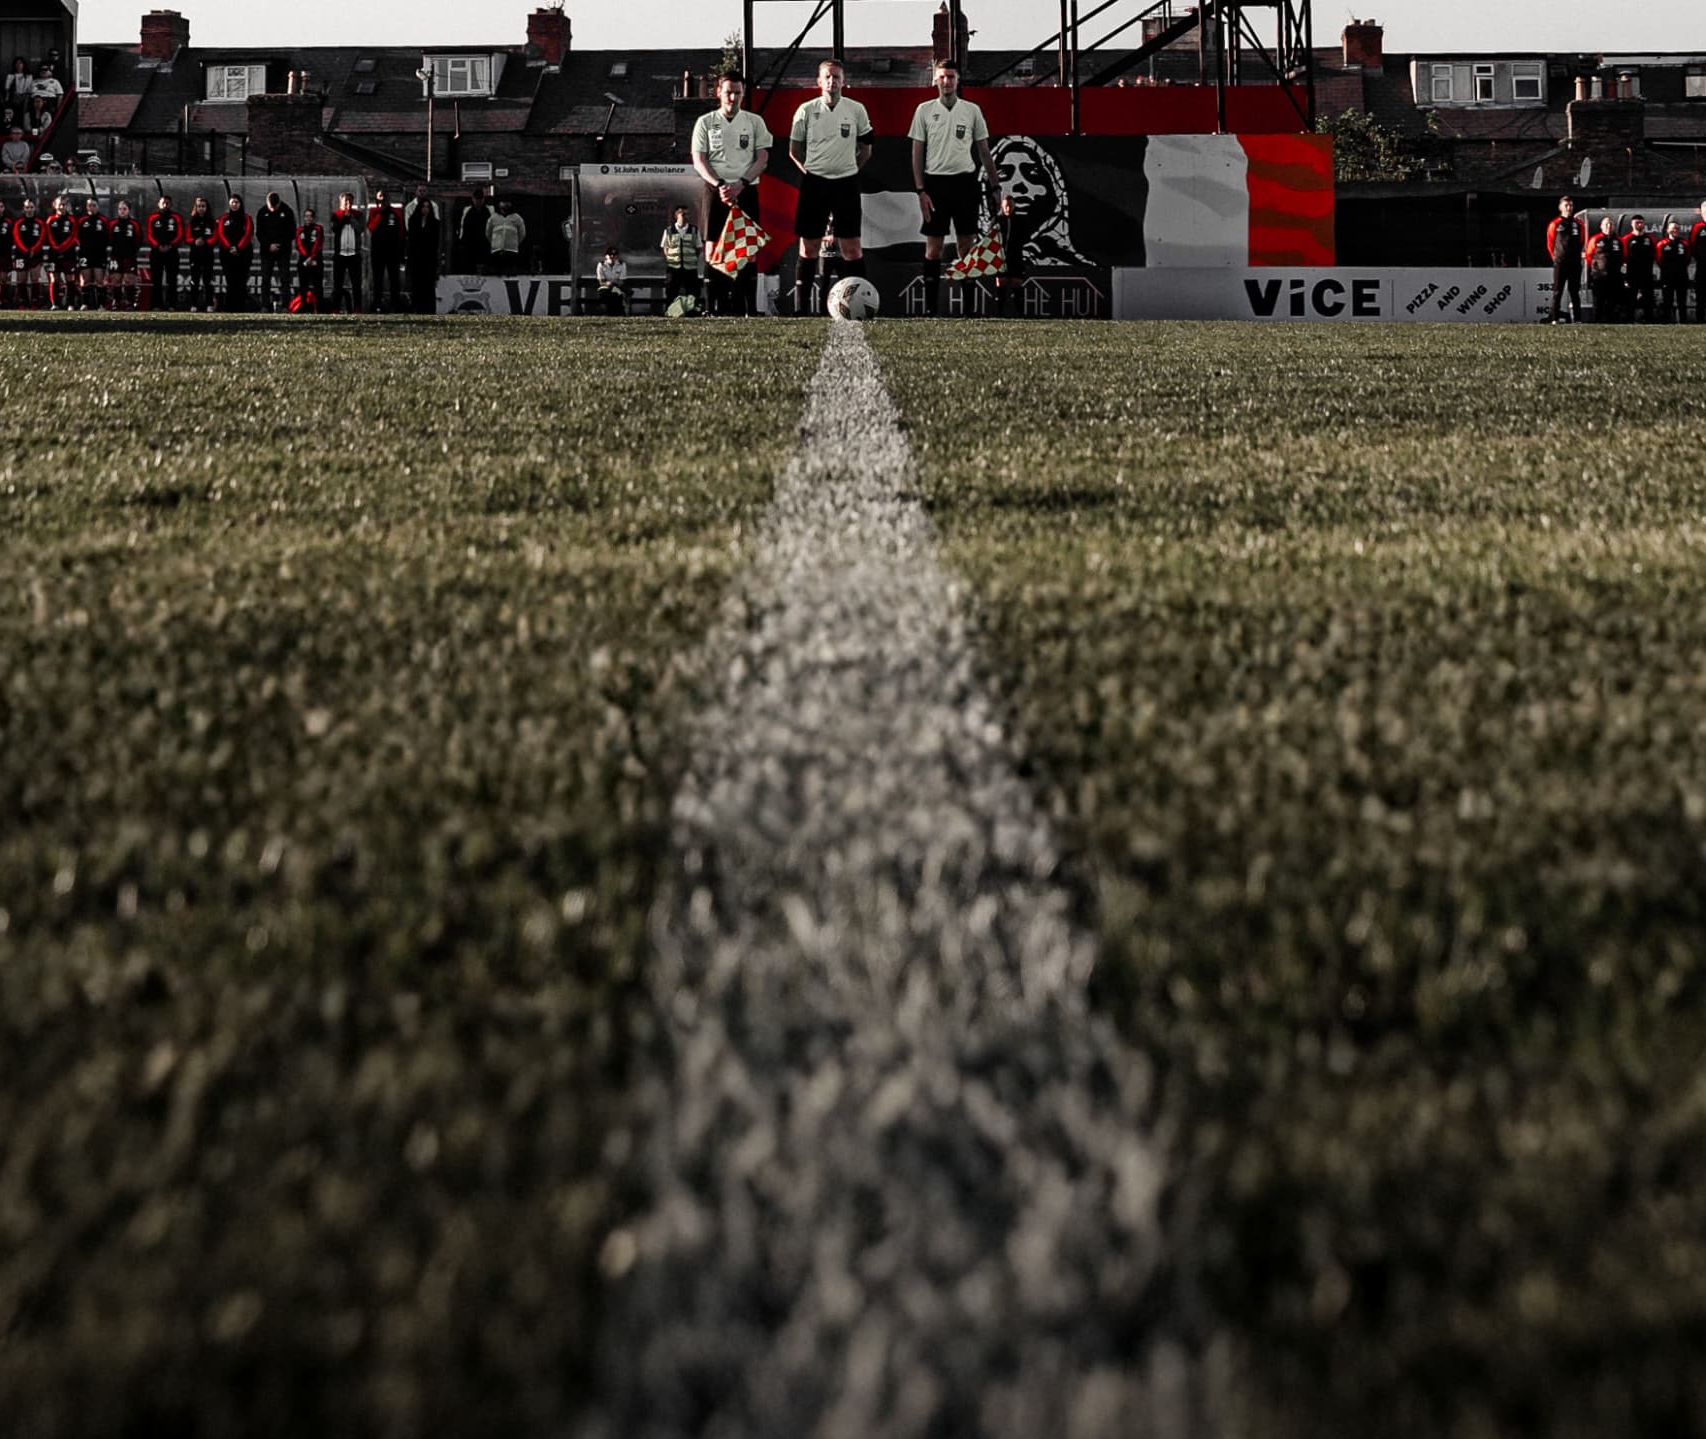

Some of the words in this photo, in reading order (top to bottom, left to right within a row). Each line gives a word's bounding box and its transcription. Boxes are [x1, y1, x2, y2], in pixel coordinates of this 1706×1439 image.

[642, 165, 685, 174] Ambulance
[1405, 282, 1440, 315] PIZZA
[1437, 285, 1461, 311] AND
[1457, 284, 1489, 315] WING
[1483, 284, 1514, 316] SHOP
